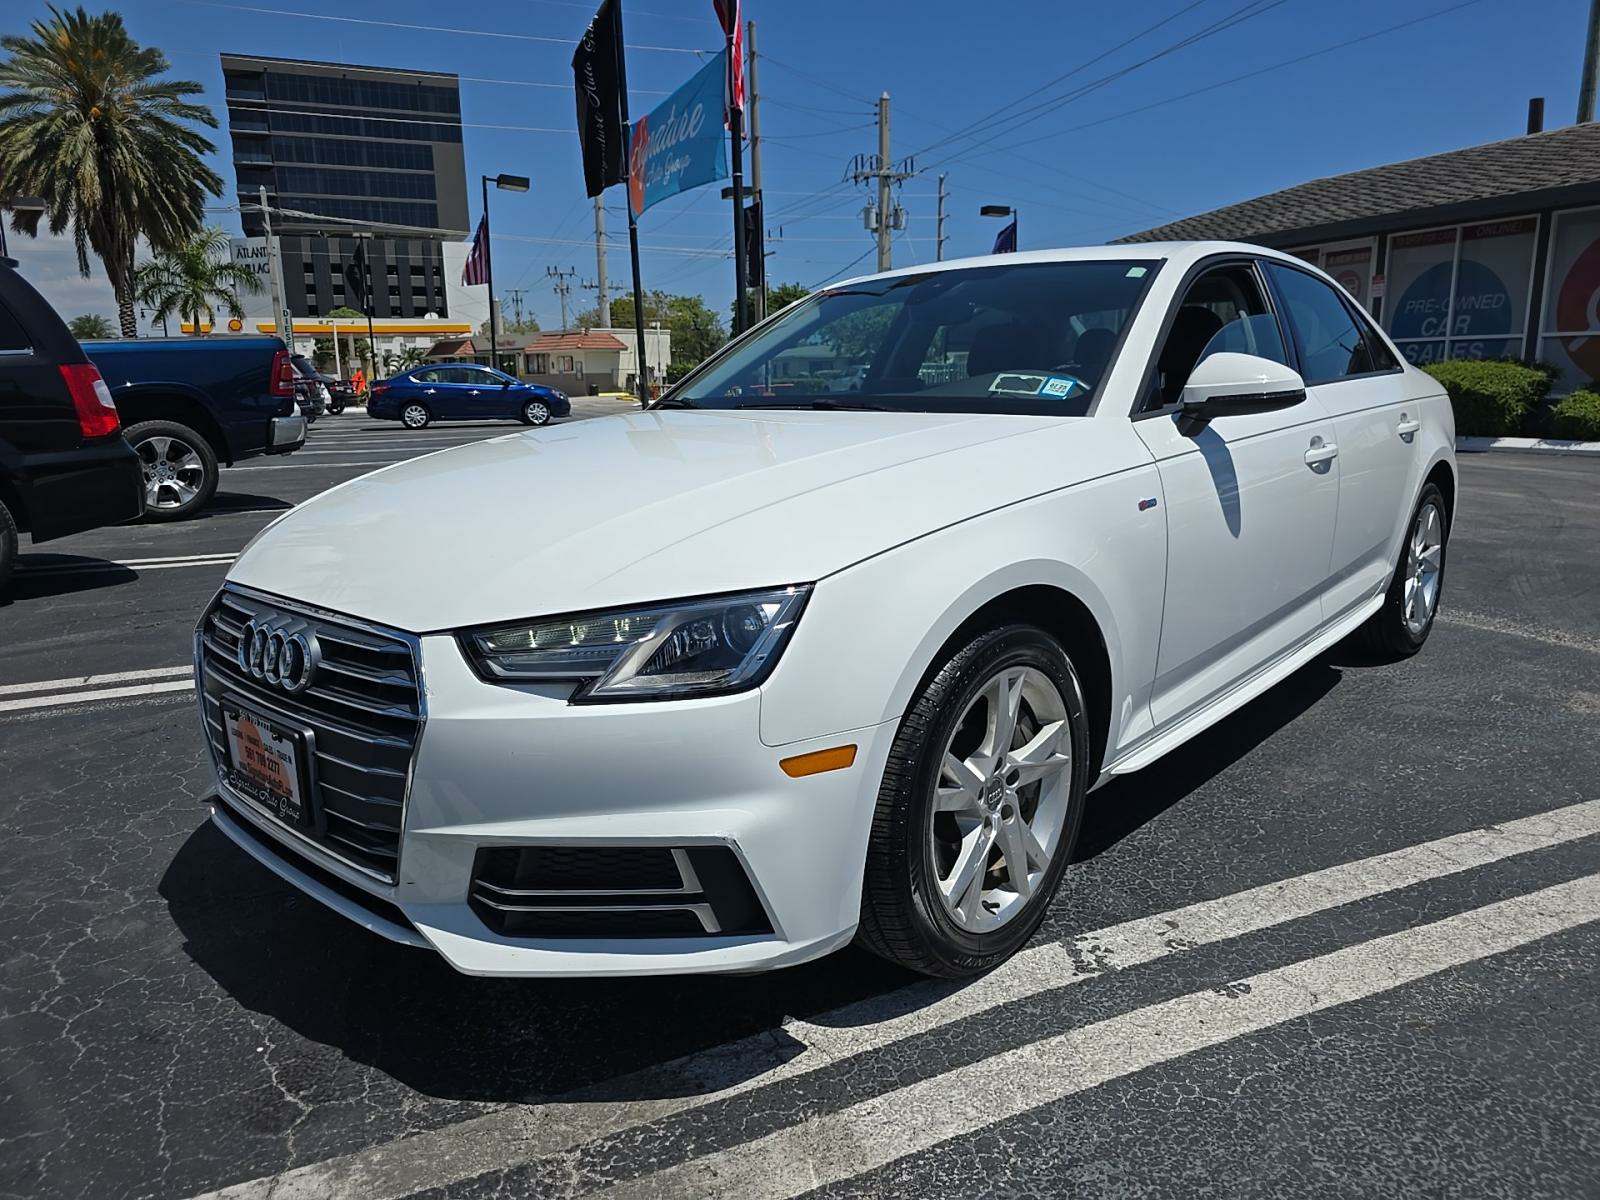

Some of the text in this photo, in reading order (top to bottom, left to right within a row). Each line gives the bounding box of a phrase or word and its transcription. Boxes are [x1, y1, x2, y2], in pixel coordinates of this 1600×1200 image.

[1404, 293, 1506, 314] PRE-OWNED
[1421, 314, 1471, 338] CAR
[1405, 340, 1485, 364] SALES
